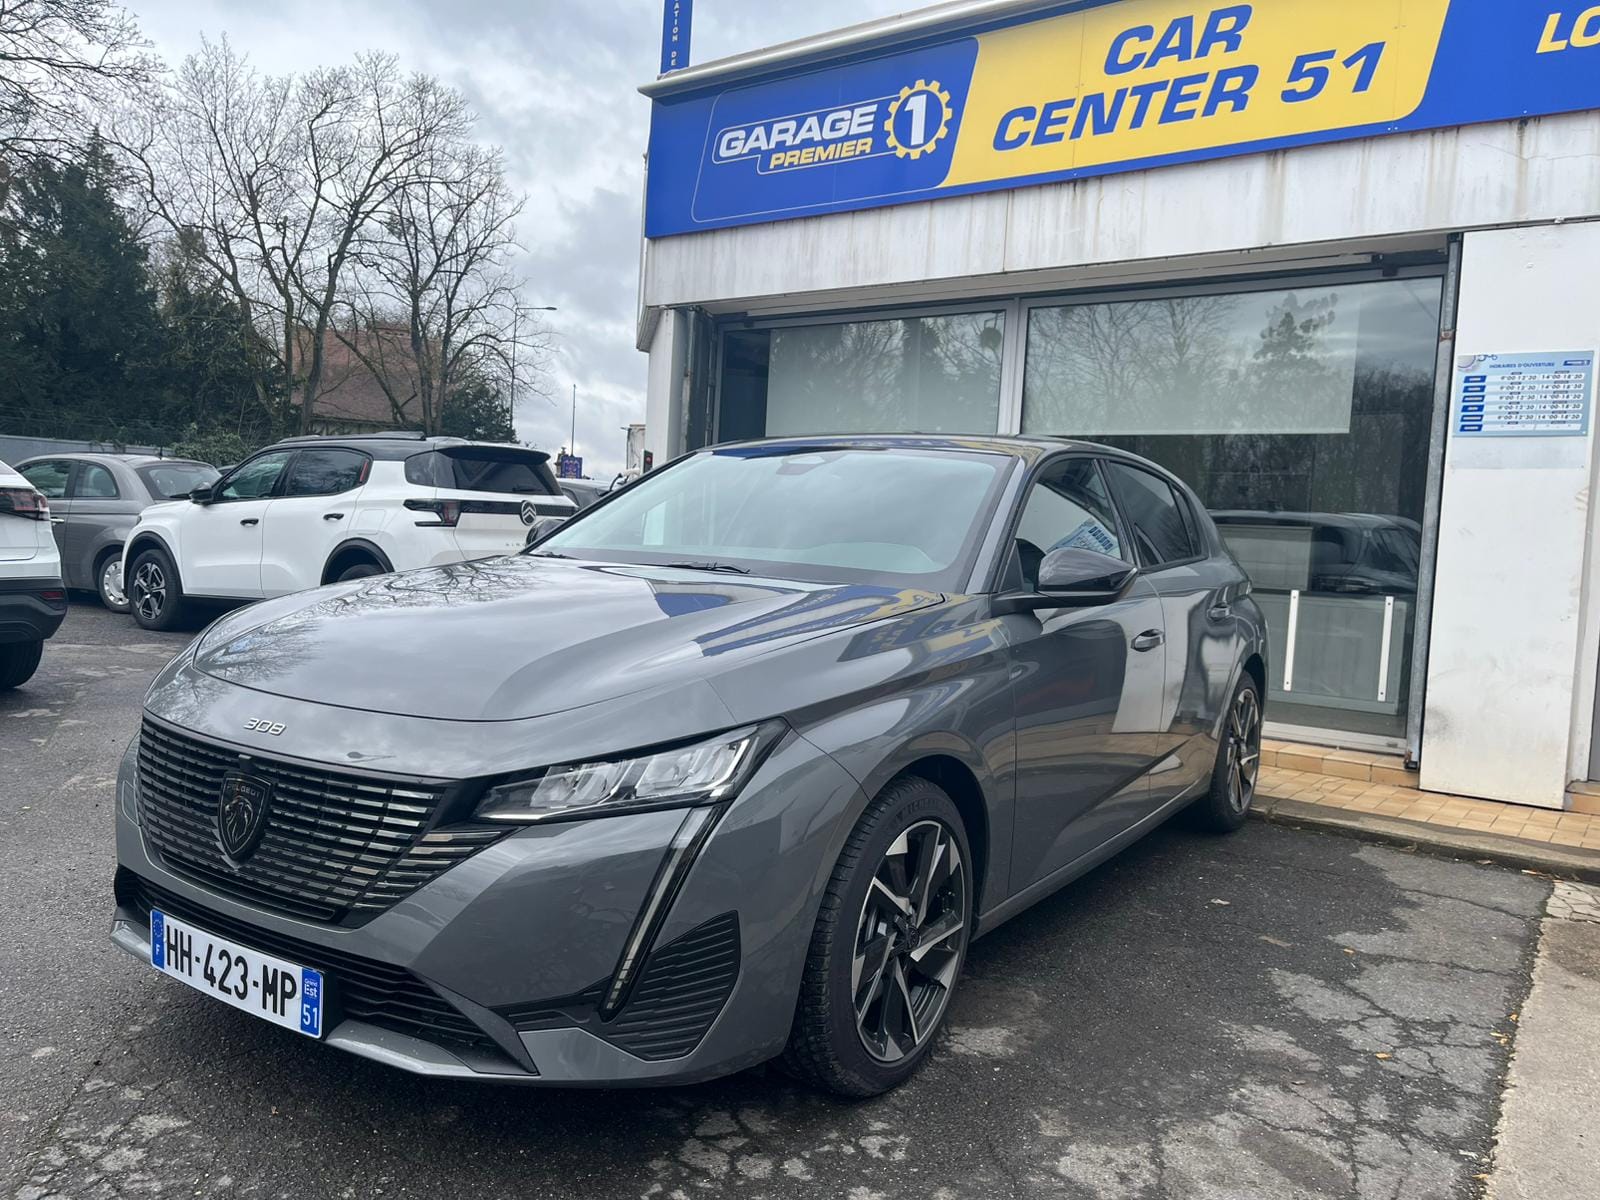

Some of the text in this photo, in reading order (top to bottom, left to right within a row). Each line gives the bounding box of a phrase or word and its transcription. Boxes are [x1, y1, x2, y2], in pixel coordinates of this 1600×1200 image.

[671, 0, 680, 42] ATION
[1104, 4, 1253, 75] CAR
[993, 41, 1385, 151] CENTER 51
[719, 104, 878, 158] GARAGE
[904, 93, 927, 146] 1
[769, 137, 873, 169] PREMIER
[243, 717, 287, 736] 308
[155, 943, 161, 955] F
[166, 925, 297, 1017] HH-423-MP
[304, 983, 318, 998] Est
[302, 1003, 318, 1029] 51
